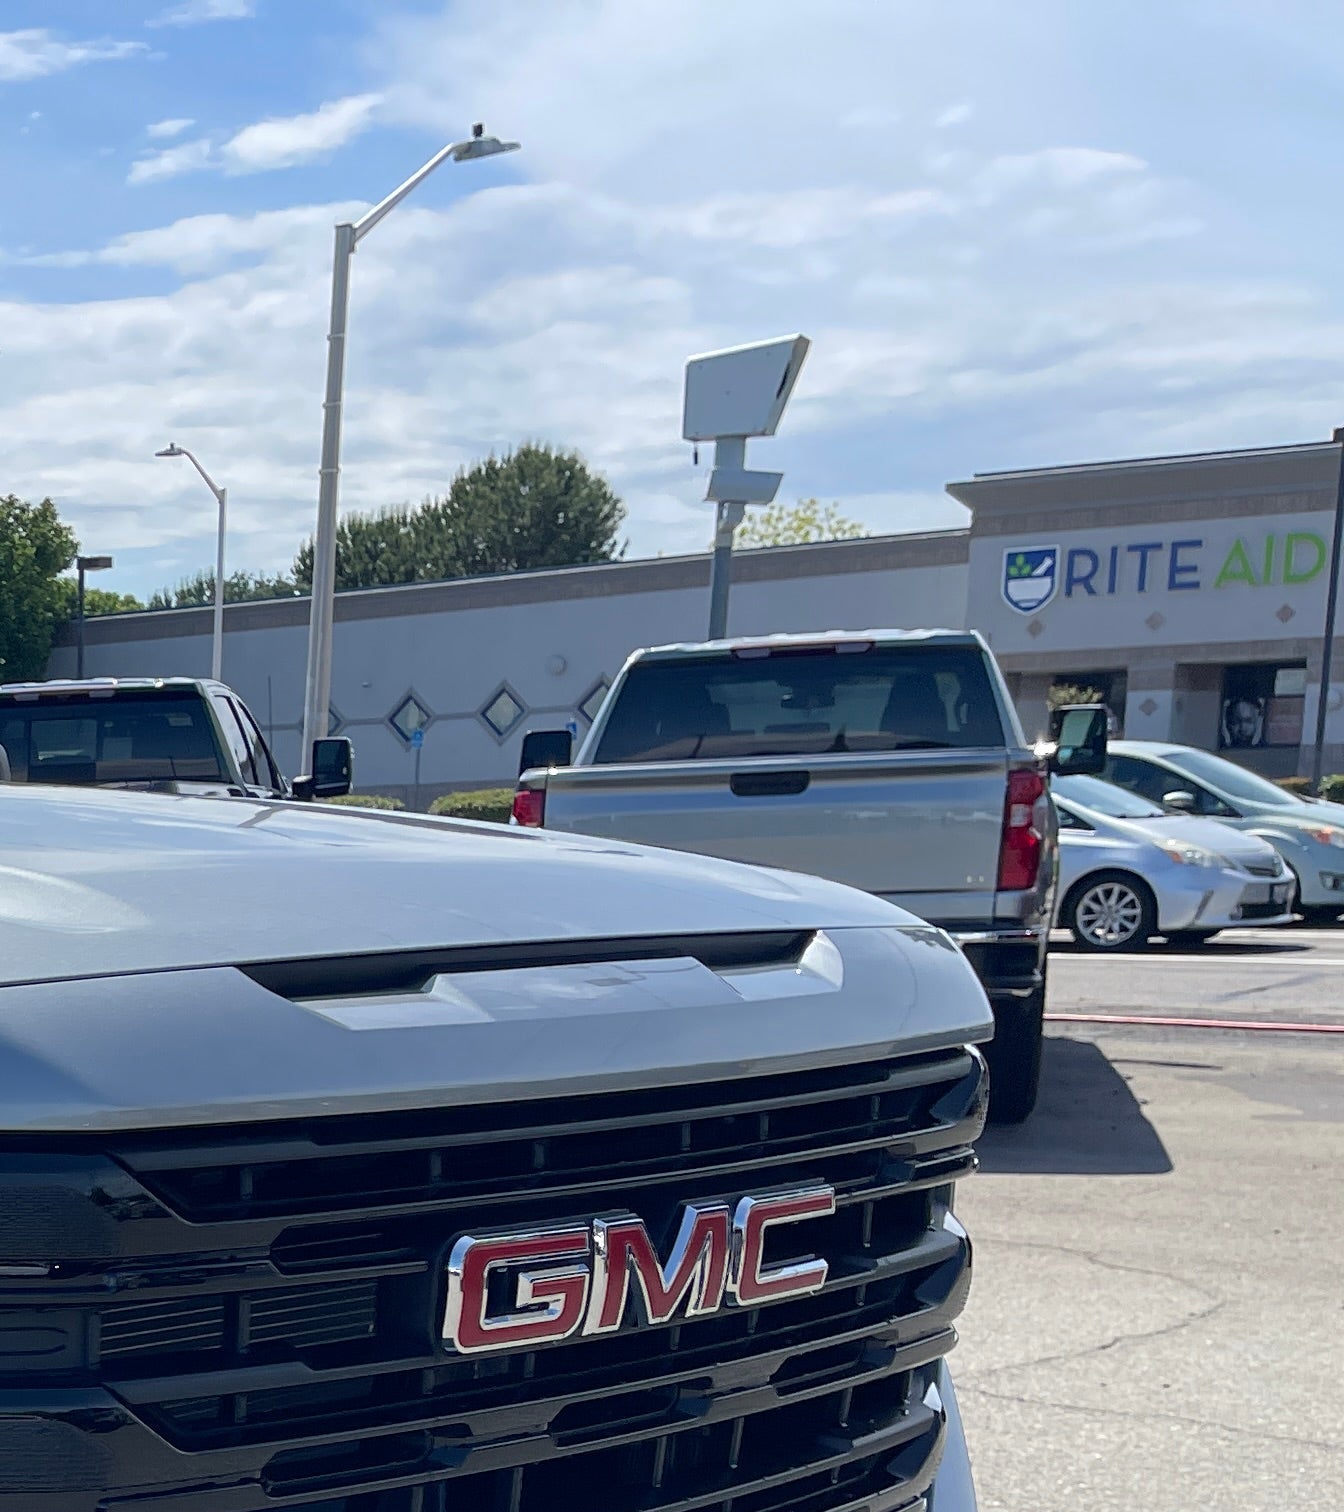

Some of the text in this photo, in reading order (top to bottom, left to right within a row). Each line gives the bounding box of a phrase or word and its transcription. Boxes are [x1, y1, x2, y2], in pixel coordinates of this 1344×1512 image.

[1064, 532, 1327, 598] RITE AID
[443, 1184, 836, 1354] GMC
